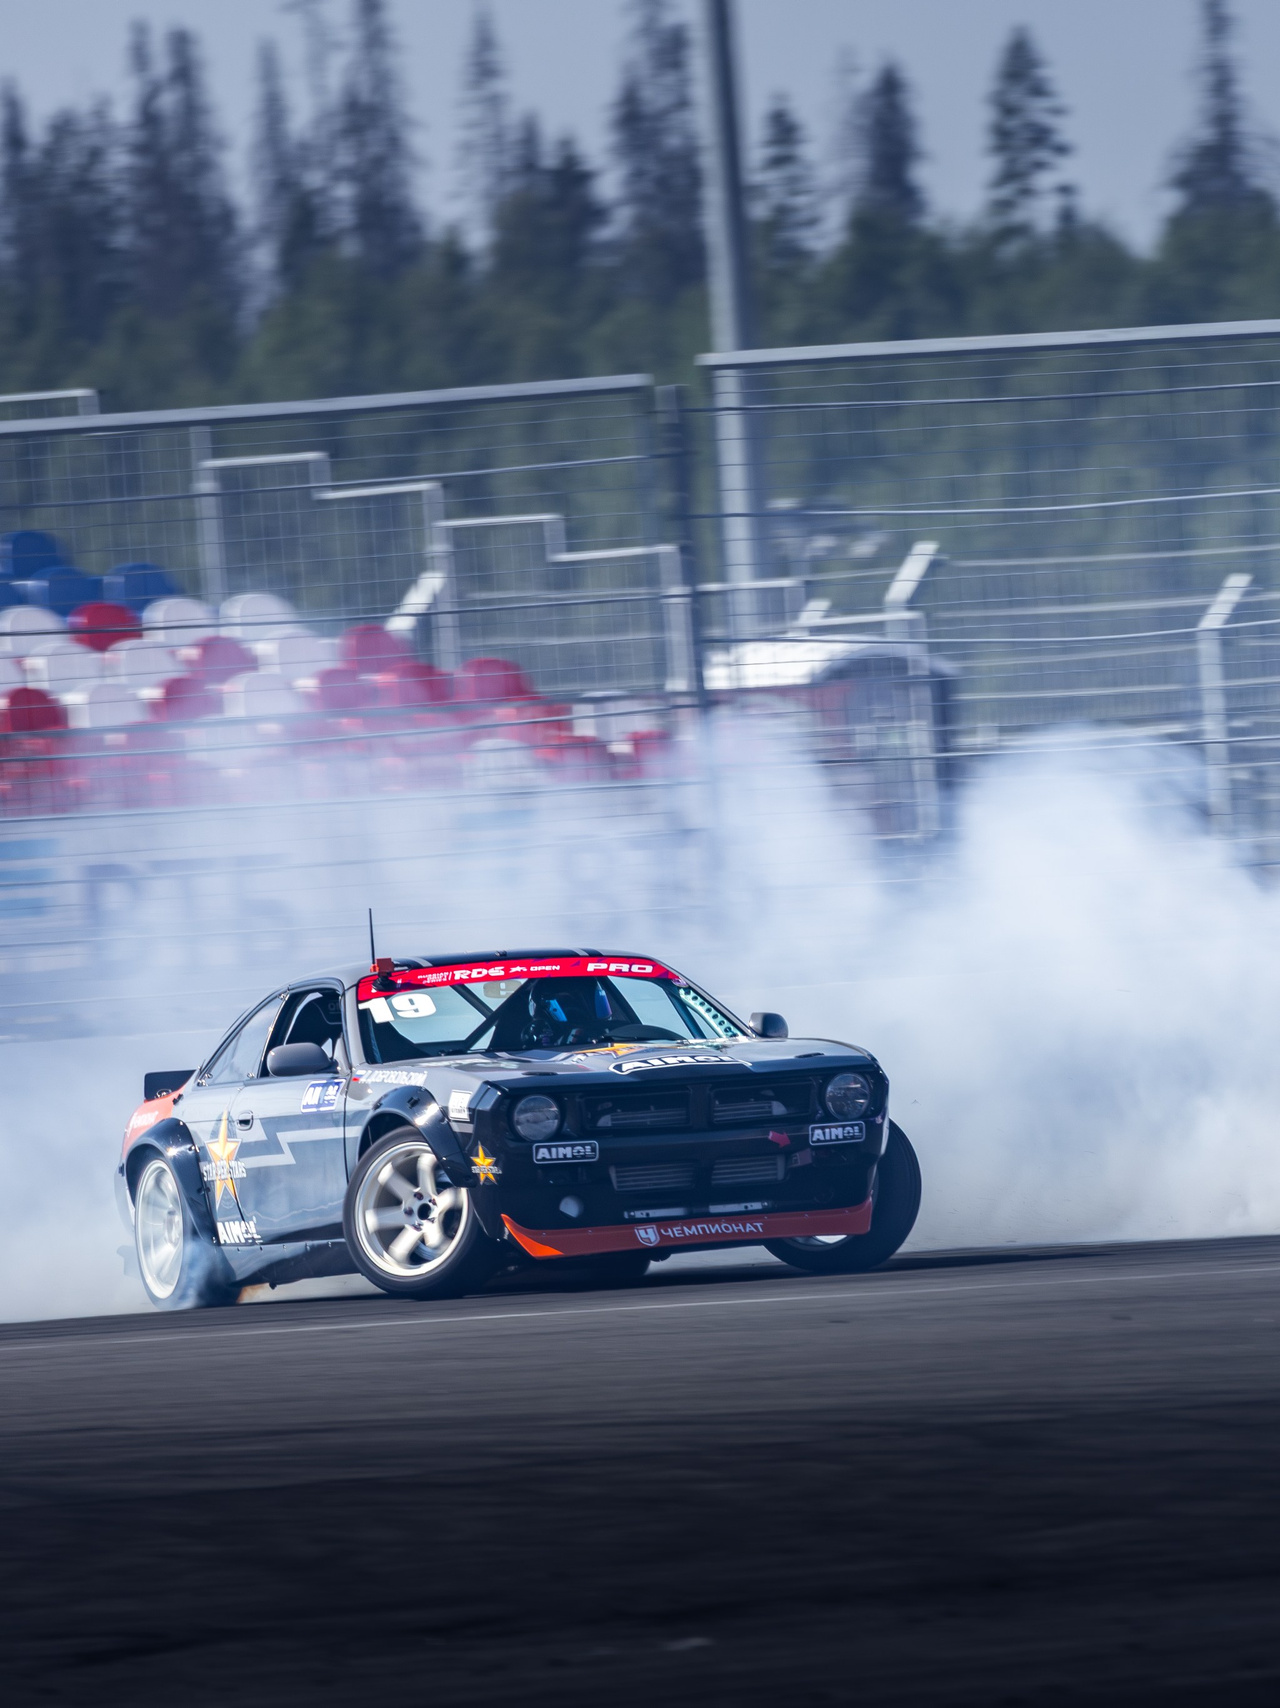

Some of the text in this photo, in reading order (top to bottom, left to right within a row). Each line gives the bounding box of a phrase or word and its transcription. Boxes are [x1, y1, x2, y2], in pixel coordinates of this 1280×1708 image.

[587, 963, 653, 973] PRO
[358, 993, 437, 1023] 19
[812, 1125, 863, 1142] AIMOL
[536, 1145, 596, 1160] AIMOL
[660, 1222, 764, 1238] ЧЕМПИОНАТ
